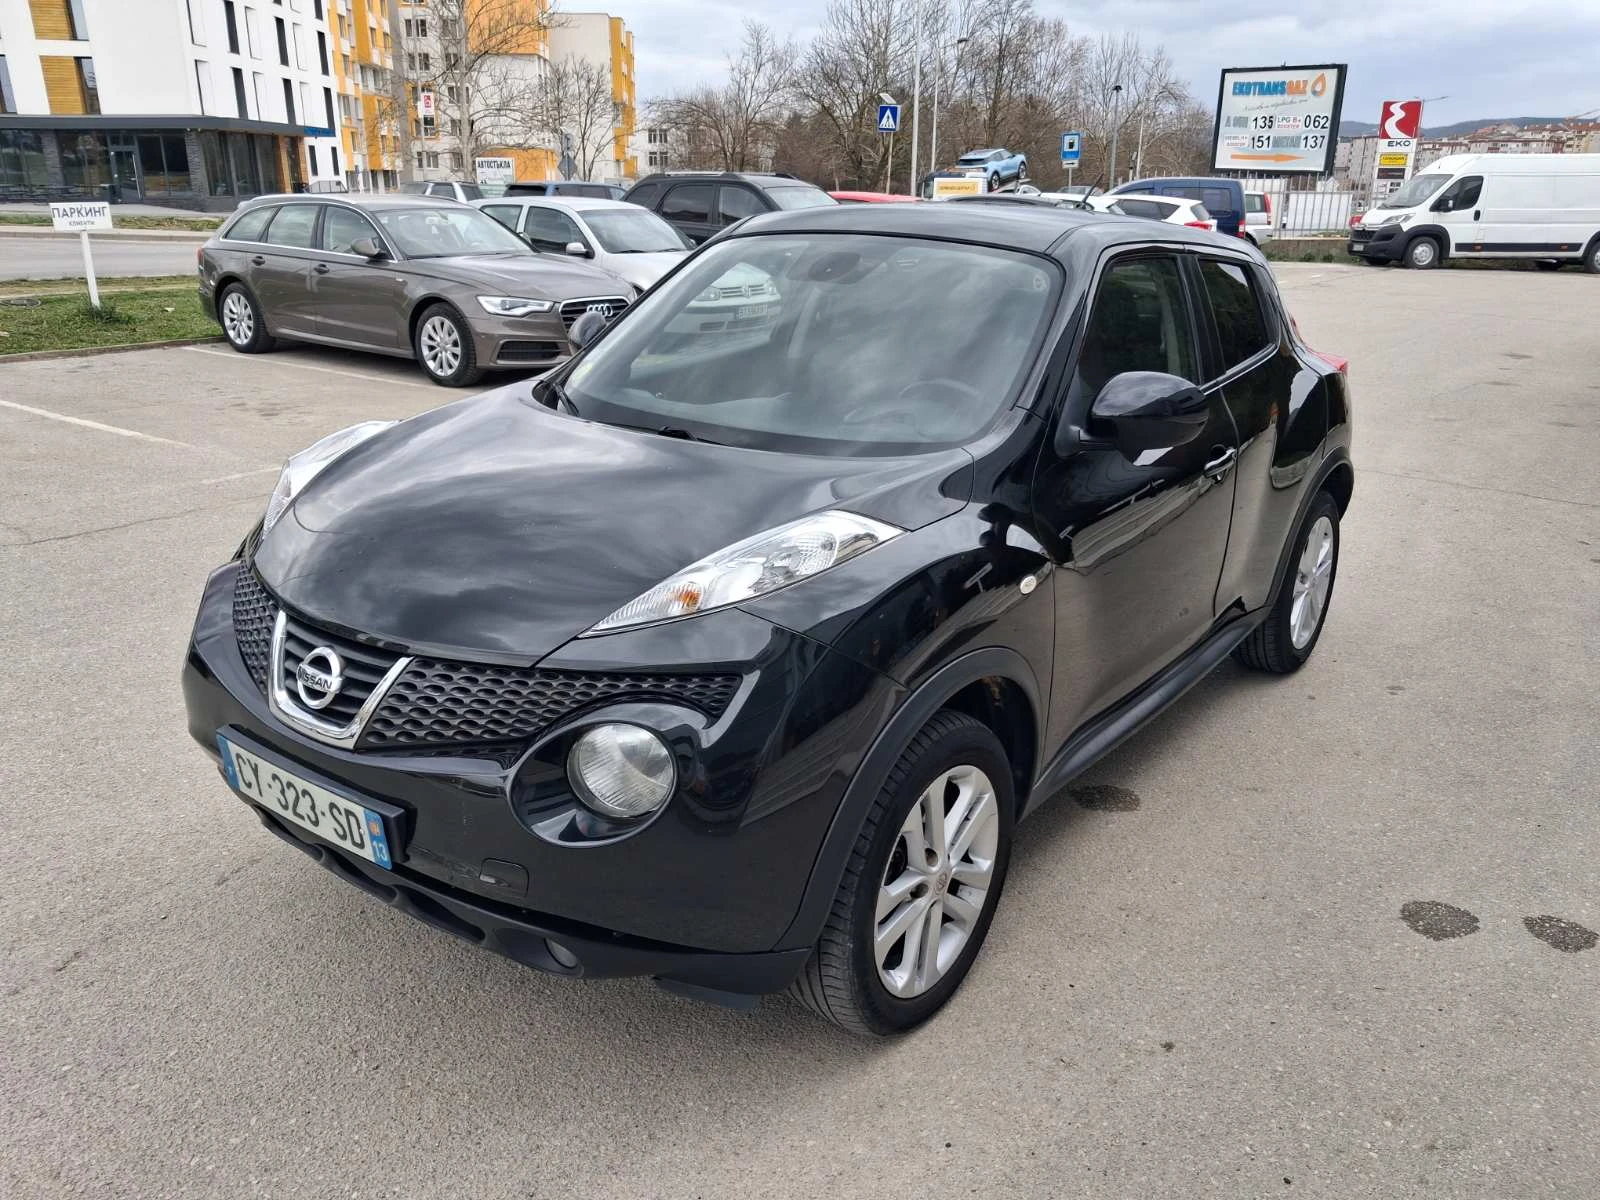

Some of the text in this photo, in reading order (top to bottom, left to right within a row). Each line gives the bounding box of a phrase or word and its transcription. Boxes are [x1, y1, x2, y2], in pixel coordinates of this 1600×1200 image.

[1252, 115, 1274, 129] 135
[1304, 114, 1329, 129] 062
[1252, 135, 1271, 149] 151
[1303, 135, 1325, 149] 137
[51, 206, 107, 219] ПАРКИНГ
[372, 840, 389, 861] 13
